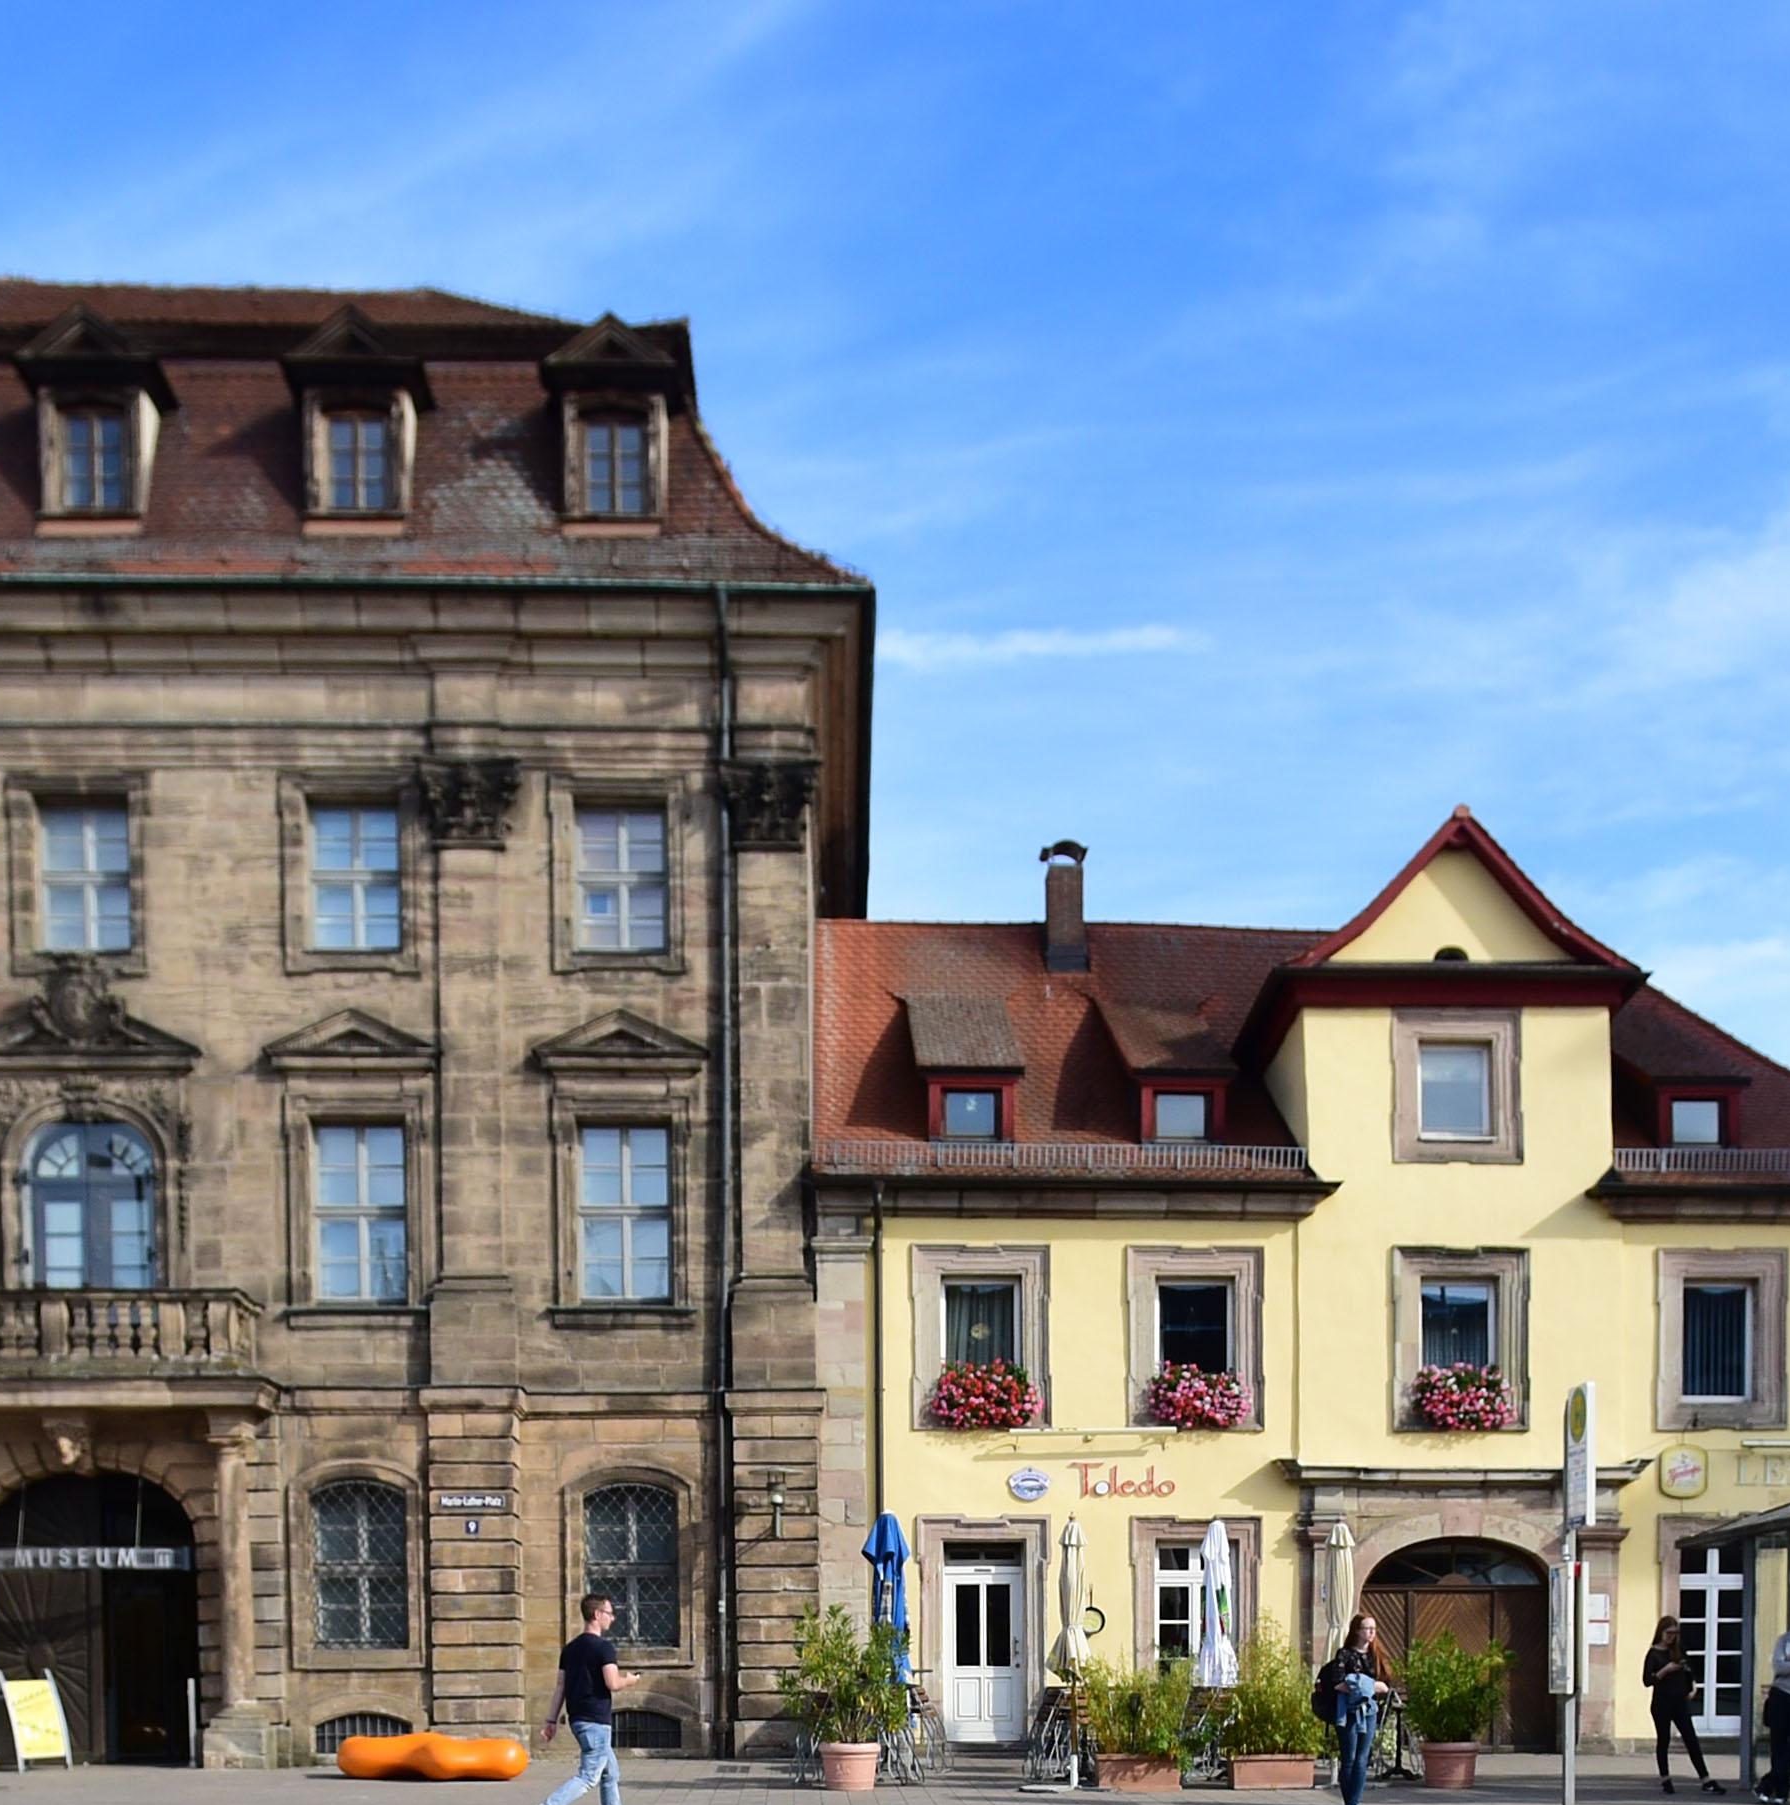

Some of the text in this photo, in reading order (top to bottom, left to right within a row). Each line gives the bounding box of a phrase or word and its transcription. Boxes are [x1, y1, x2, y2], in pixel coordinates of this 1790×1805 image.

[1068, 1462, 1176, 1498] Toledo
[468, 1521, 477, 1532] 9
[14, 1548, 137, 1568] MUSEUM
